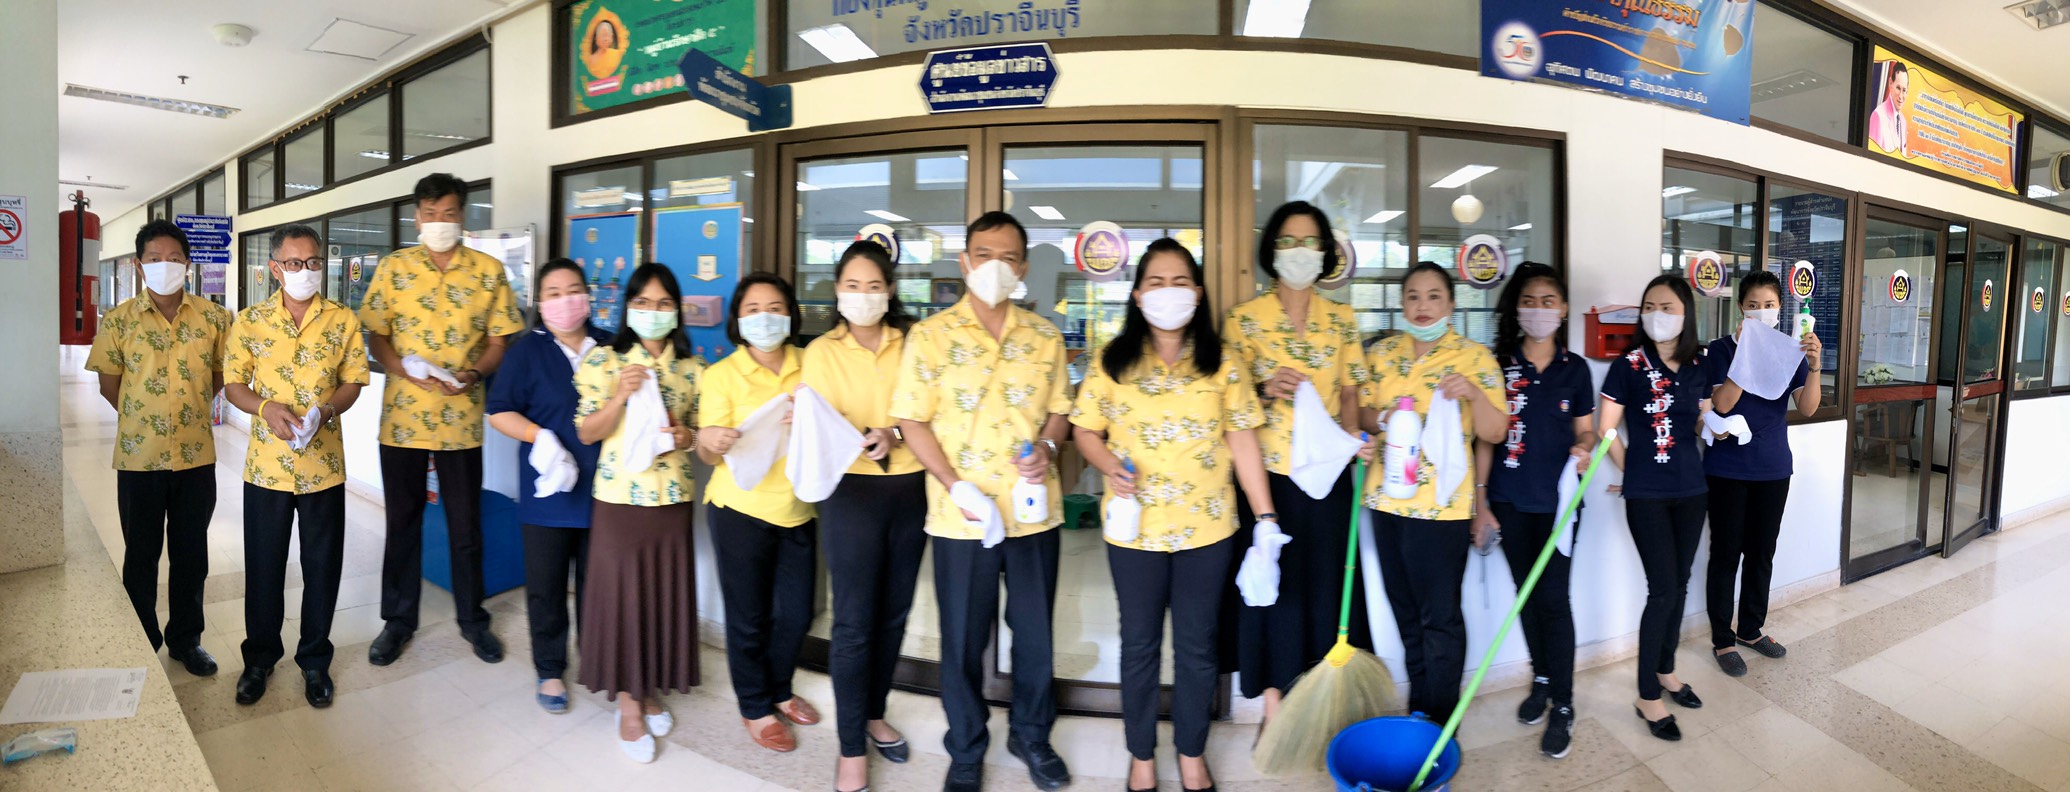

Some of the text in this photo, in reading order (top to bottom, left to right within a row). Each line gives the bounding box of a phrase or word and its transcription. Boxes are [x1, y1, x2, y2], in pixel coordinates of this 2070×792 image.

[904, 0, 1081, 44] จังหวัดปราจีนบุรี
[930, 49, 1047, 88] ศูนย์ข้อมูลข่าวสาร
